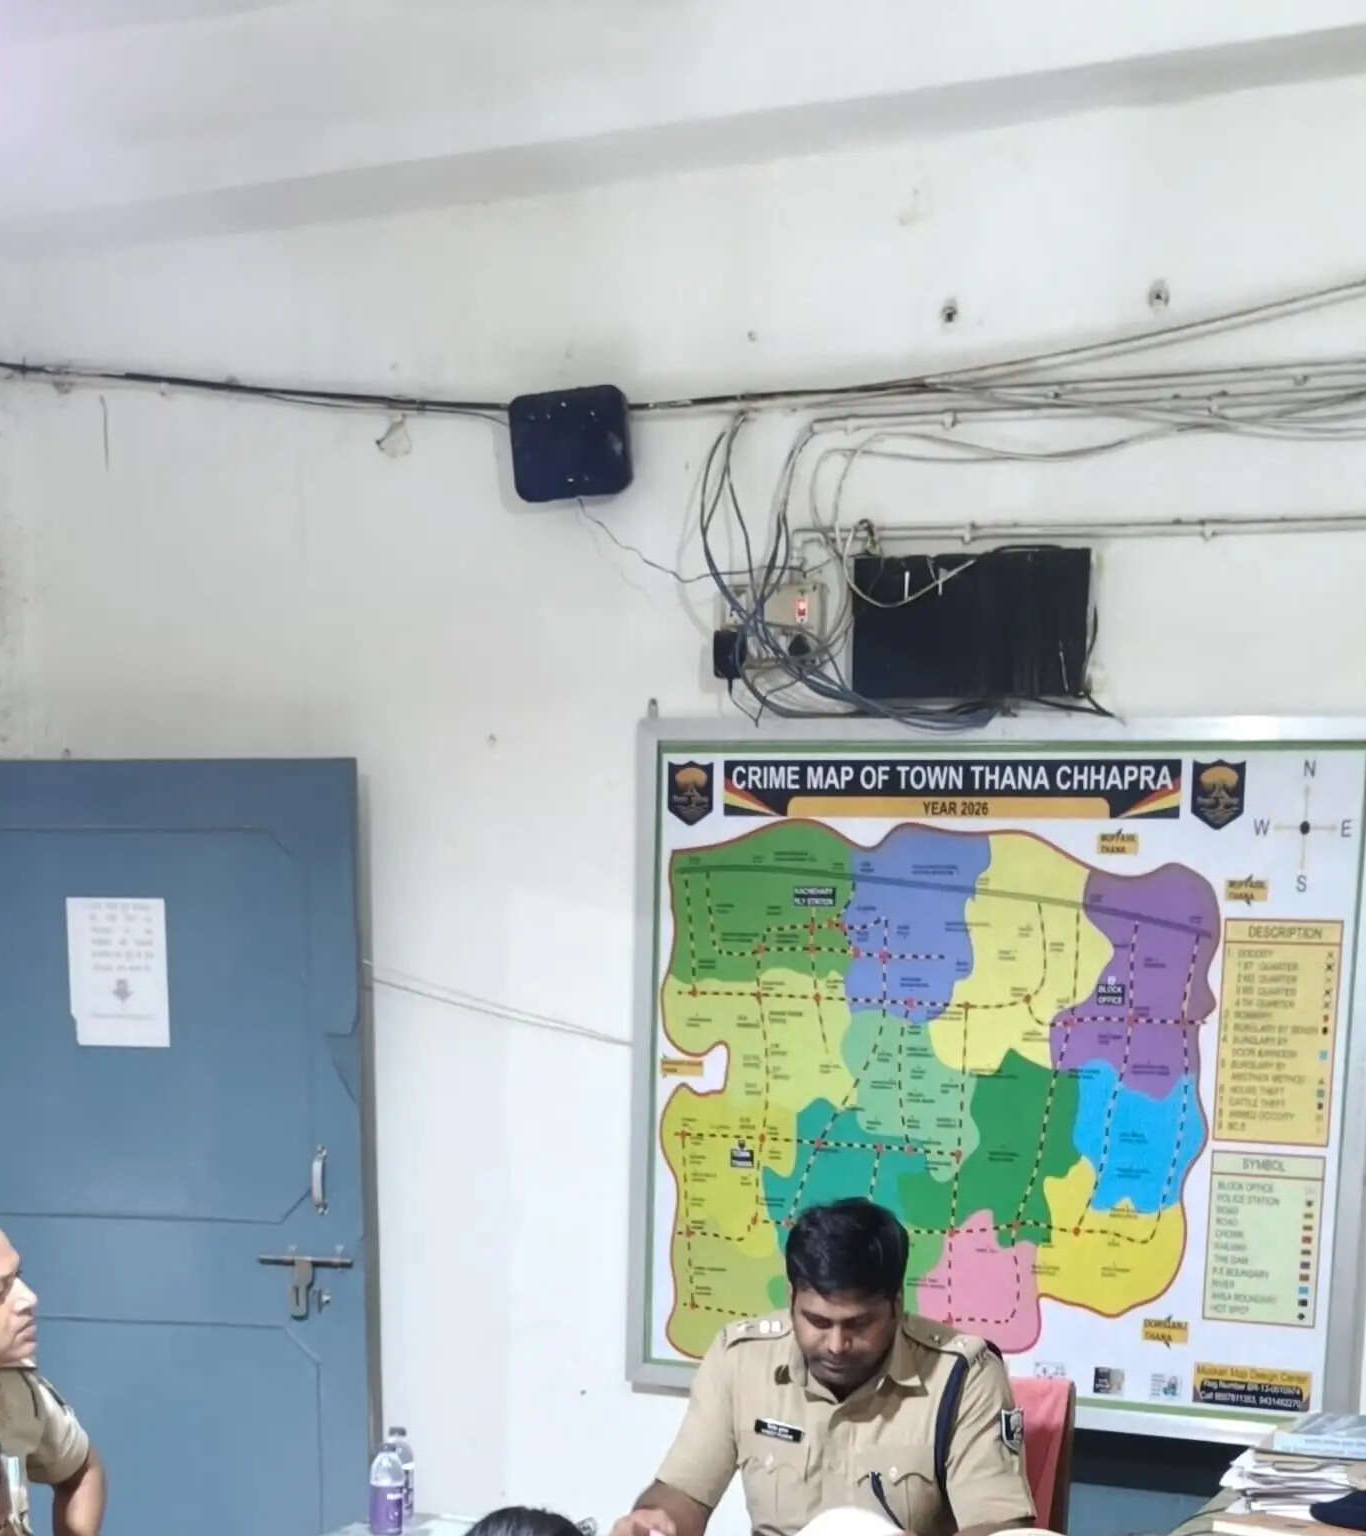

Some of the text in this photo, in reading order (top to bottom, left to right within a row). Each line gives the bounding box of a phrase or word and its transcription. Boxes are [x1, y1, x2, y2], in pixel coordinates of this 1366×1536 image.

[731, 764, 1173, 791] CRIME MAP OF TOWN THANA CHHAPRA
[1304, 761, 1315, 777] N
[923, 801, 989, 815] YEAR 2026
[1254, 819, 1270, 836] W
[1341, 820, 1351, 837] E
[1296, 875, 1307, 892] S
[1248, 925, 1323, 940] DESCRIPTION
